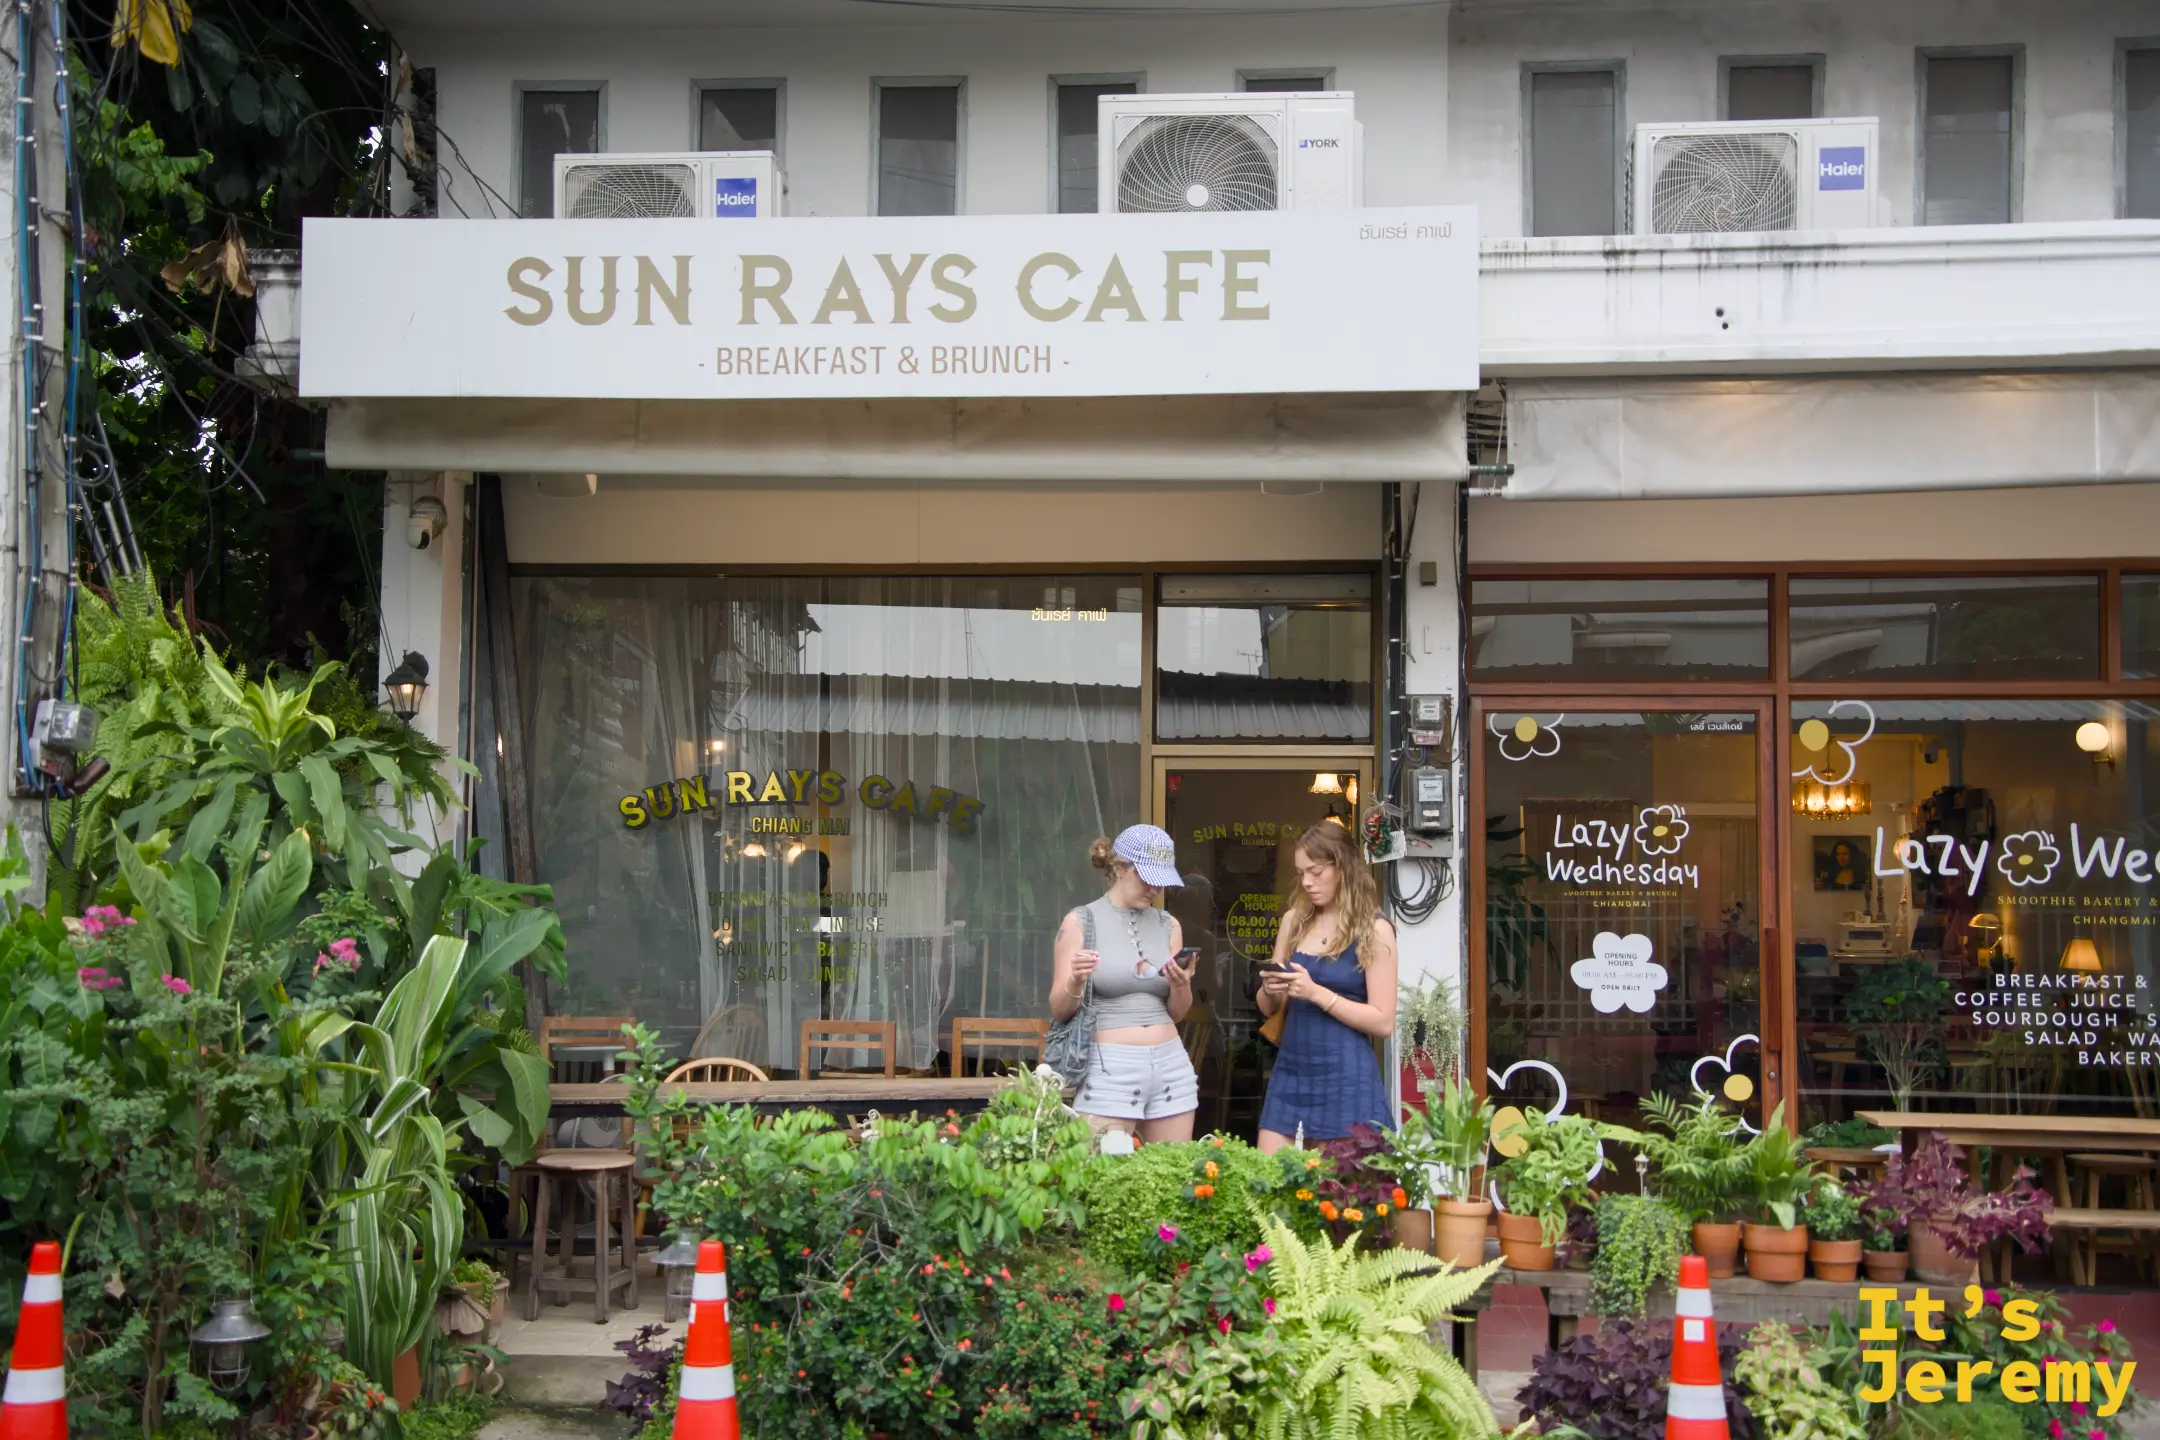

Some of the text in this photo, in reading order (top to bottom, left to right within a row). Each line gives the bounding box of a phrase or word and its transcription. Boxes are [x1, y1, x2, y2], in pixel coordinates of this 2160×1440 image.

[1309, 139, 1339, 148] YORK
[1820, 162, 1864, 176] Haier
[717, 192, 756, 206] Haier
[503, 249, 1272, 326] SUN RAYS CAFE
[717, 346, 886, 376] BREAKFAST
[897, 347, 920, 375] &
[932, 345, 1052, 374] BRUNCH
[619, 769, 986, 835] SUN RAYS CAFE
[752, 817, 850, 836] CHIANG MAI
[1193, 824, 1227, 843] SUN
[1233, 822, 1276, 837] RAYS
[1553, 814, 1629, 860] Lazy
[1873, 822, 2160, 896] Lazy We
[1546, 851, 1698, 888] Wednesday
[1997, 895, 2158, 906] SMOOTHIE BAKERY &
[1230, 915, 1266, 927] 08.00
[2073, 916, 2156, 925] CHIANGMAI
[1237, 928, 1269, 938] 05.00
[1995, 974, 2148, 989] BREAKFAST &
[1954, 992, 2042, 1006] COFFEE
[2070, 994, 2136, 1008] JUICE
[1972, 1012, 2117, 1027] SOURDOUGH
[2025, 1031, 2097, 1045] SALAD
